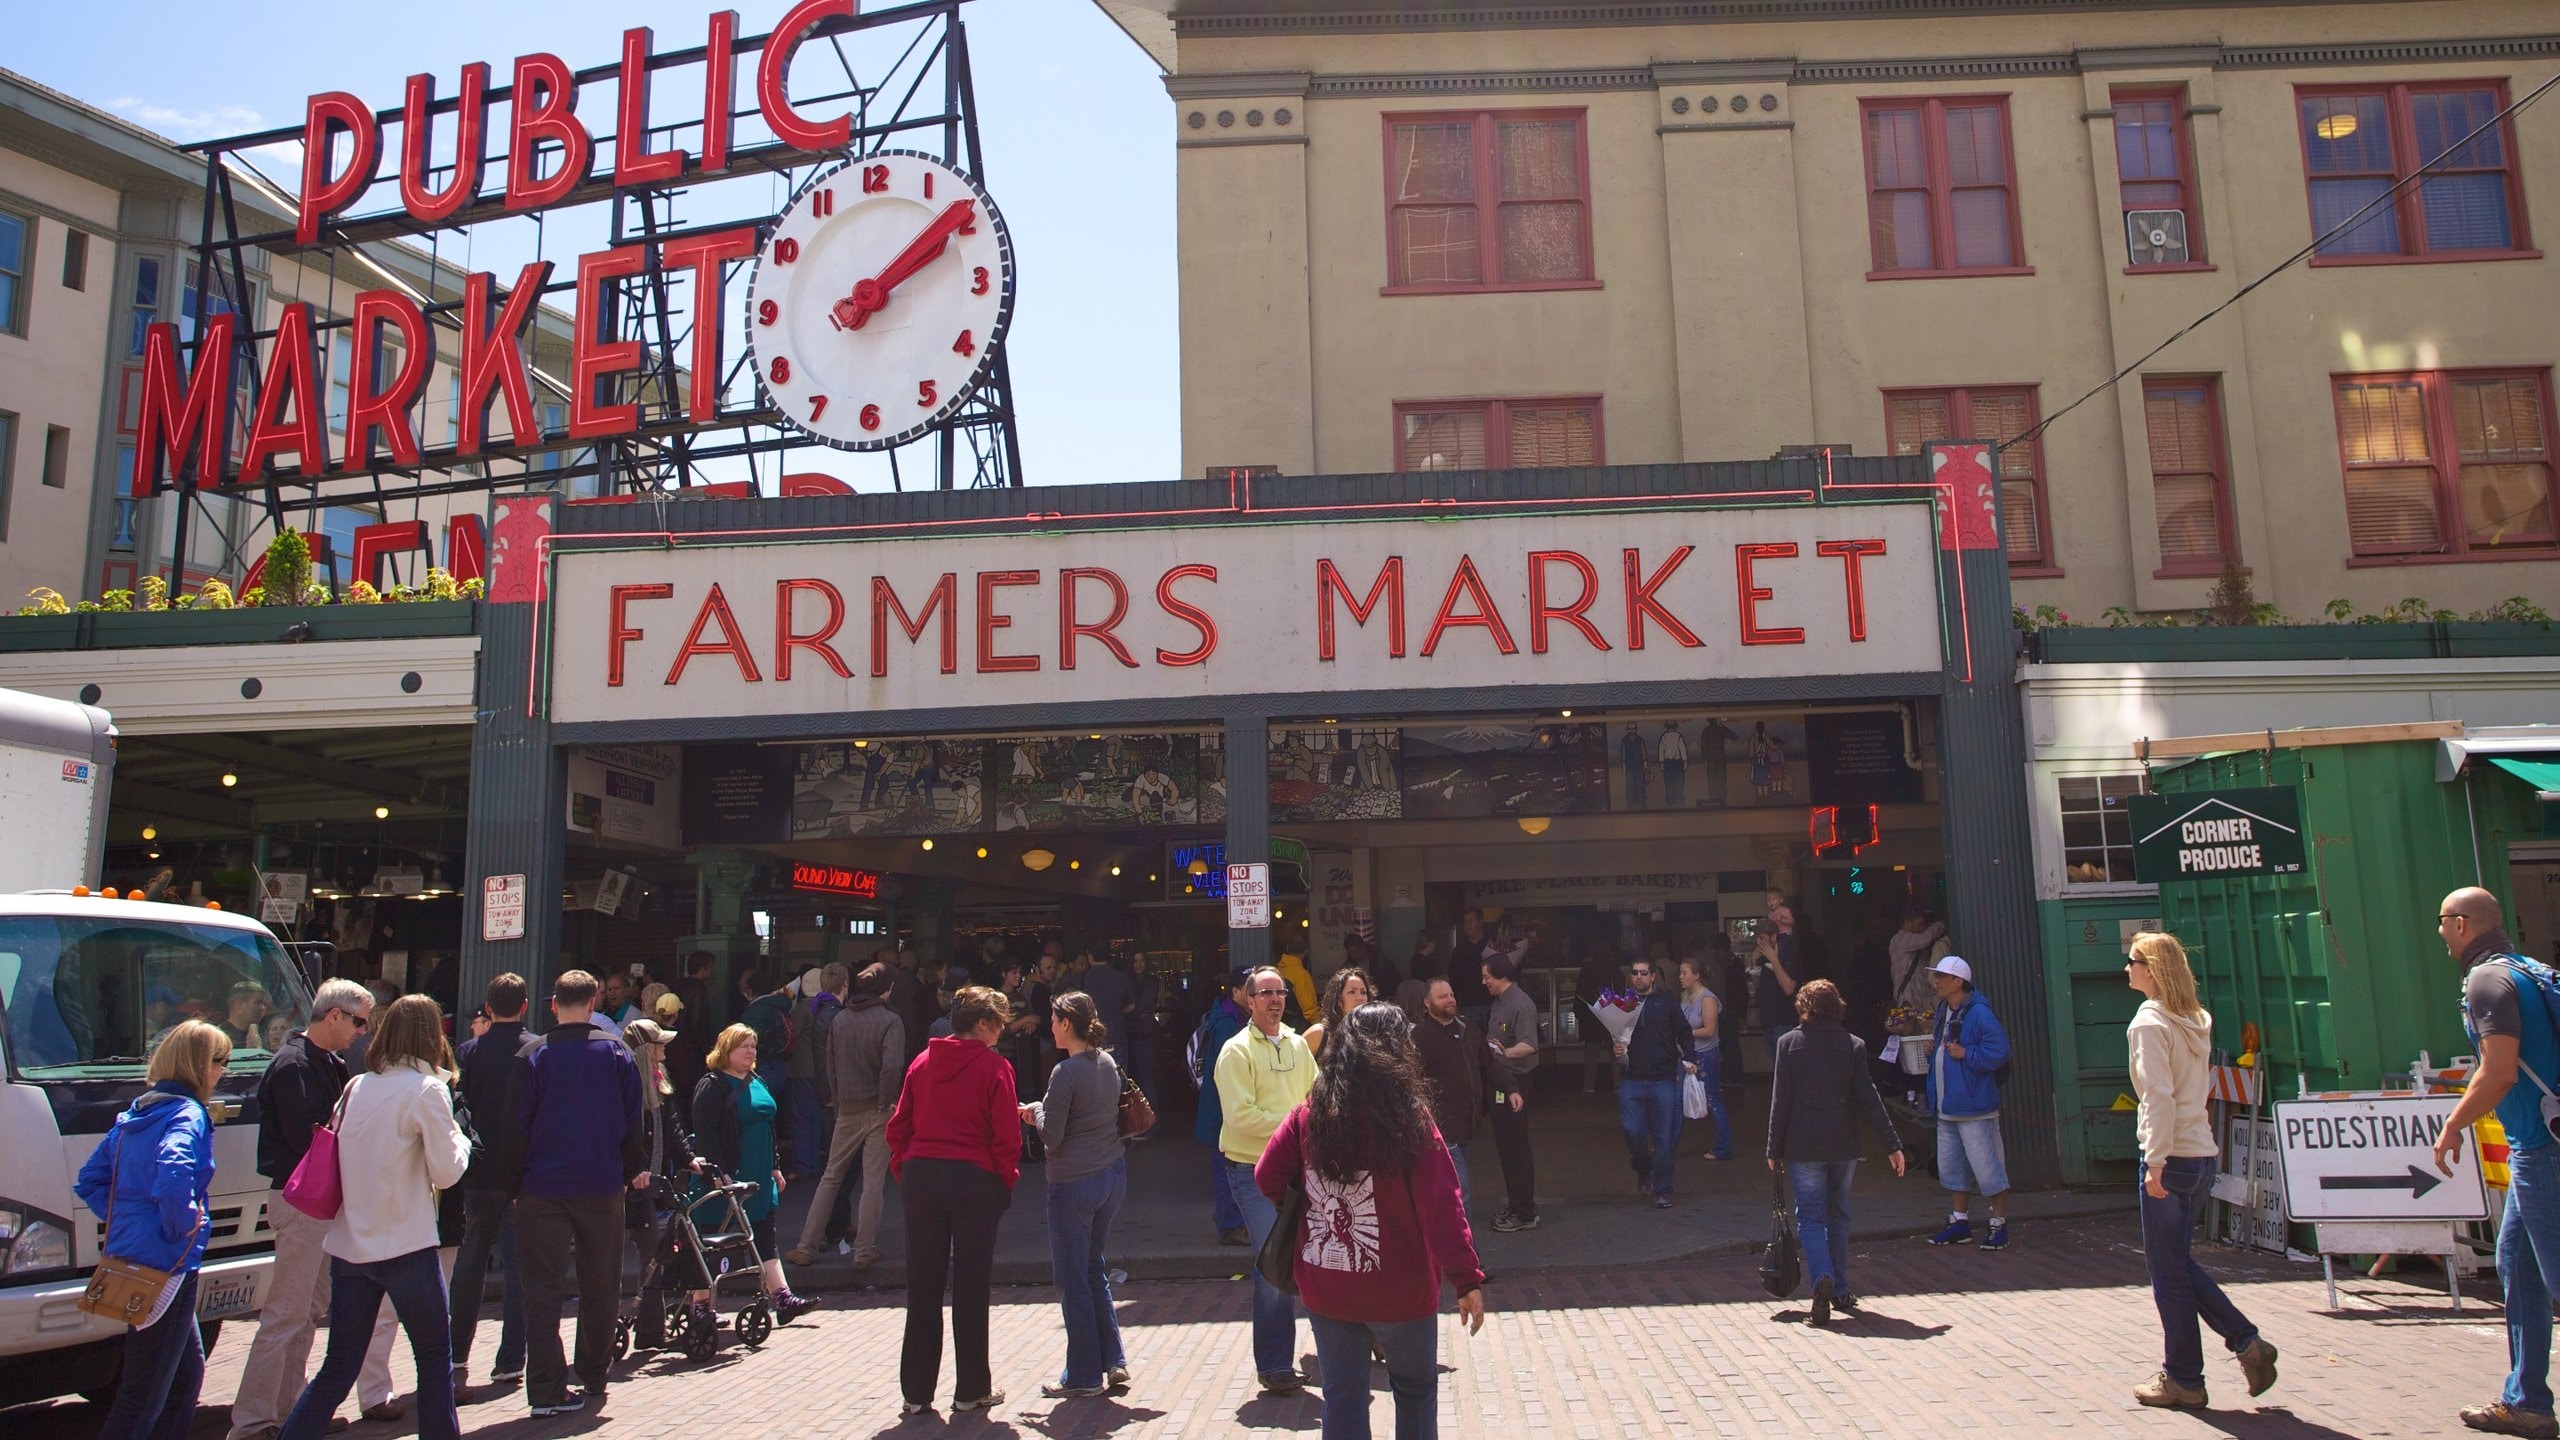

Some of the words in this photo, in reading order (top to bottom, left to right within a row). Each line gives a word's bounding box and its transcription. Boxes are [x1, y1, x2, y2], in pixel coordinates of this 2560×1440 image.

[296, 0, 857, 244] PUBLIC
[863, 164, 889, 193] 12
[924, 172, 933, 199] 1
[813, 189, 833, 217] 11
[774, 238, 799, 266] 10
[971, 267, 990, 296] 3
[758, 300, 779, 327] 9
[953, 330, 976, 358] 4
[131, 228, 756, 498] MARKET
[770, 356, 791, 385] 8
[918, 380, 938, 408] 5
[808, 395, 829, 423] 7
[860, 405, 881, 431] 6
[608, 563, 1219, 687] FARMERS
[1317, 539, 1887, 660] MARKET
[2181, 818, 2252, 844] CORNER
[2179, 845, 2262, 872] PRODUCE
[489, 878, 504, 891] NO
[1231, 867, 1247, 879] NO
[489, 892, 520, 905] STOPS
[1232, 882, 1264, 893] STOPS
[495, 918, 513, 927] ZONE
[2286, 1114, 2464, 1149] PEDESTRIAN
[2263, 1190, 2281, 1211] ARE
